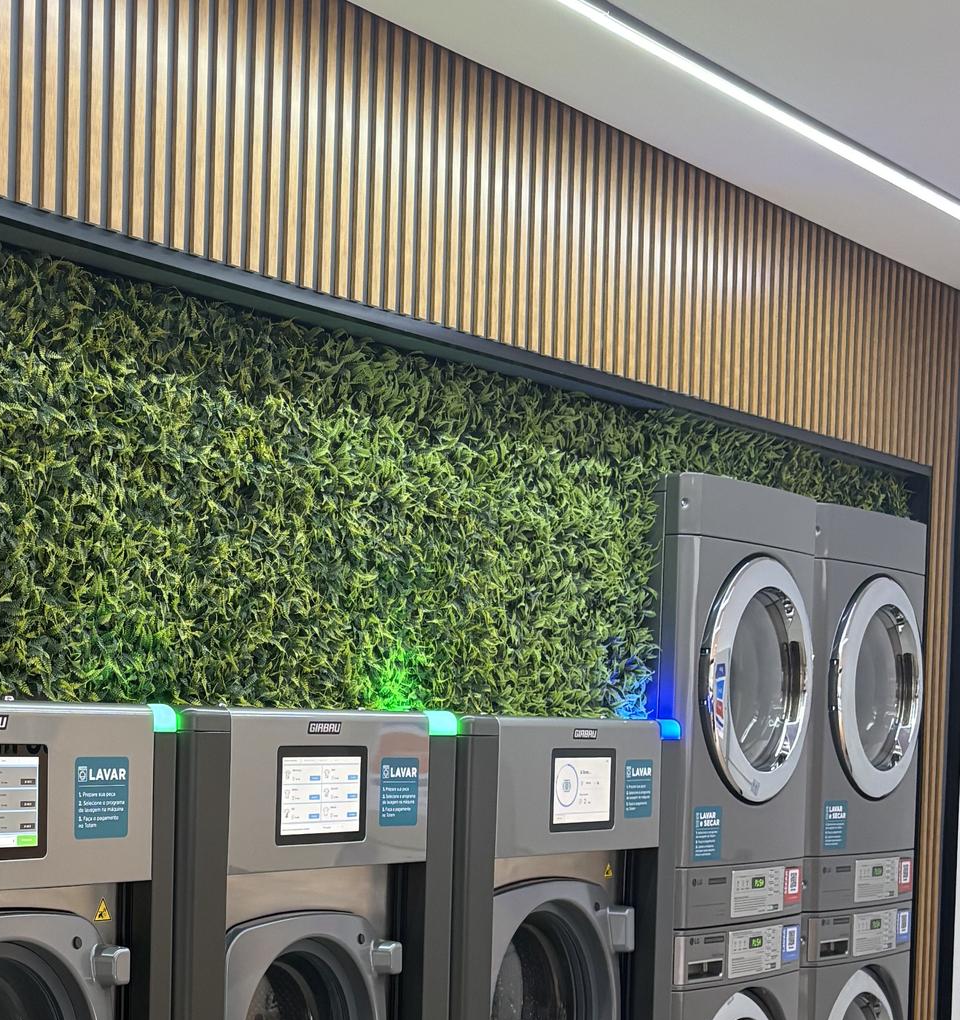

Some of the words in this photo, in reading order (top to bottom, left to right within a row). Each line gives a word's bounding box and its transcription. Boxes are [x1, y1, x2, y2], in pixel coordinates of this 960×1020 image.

[309, 723, 340, 733] GIRBAU
[89, 768, 126, 781] LAVAR
[390, 767, 417, 778] LAVAR
[632, 767, 652, 776] LAVAR
[700, 812, 716, 820] LAVAR
[704, 819, 720, 827] SECAR
